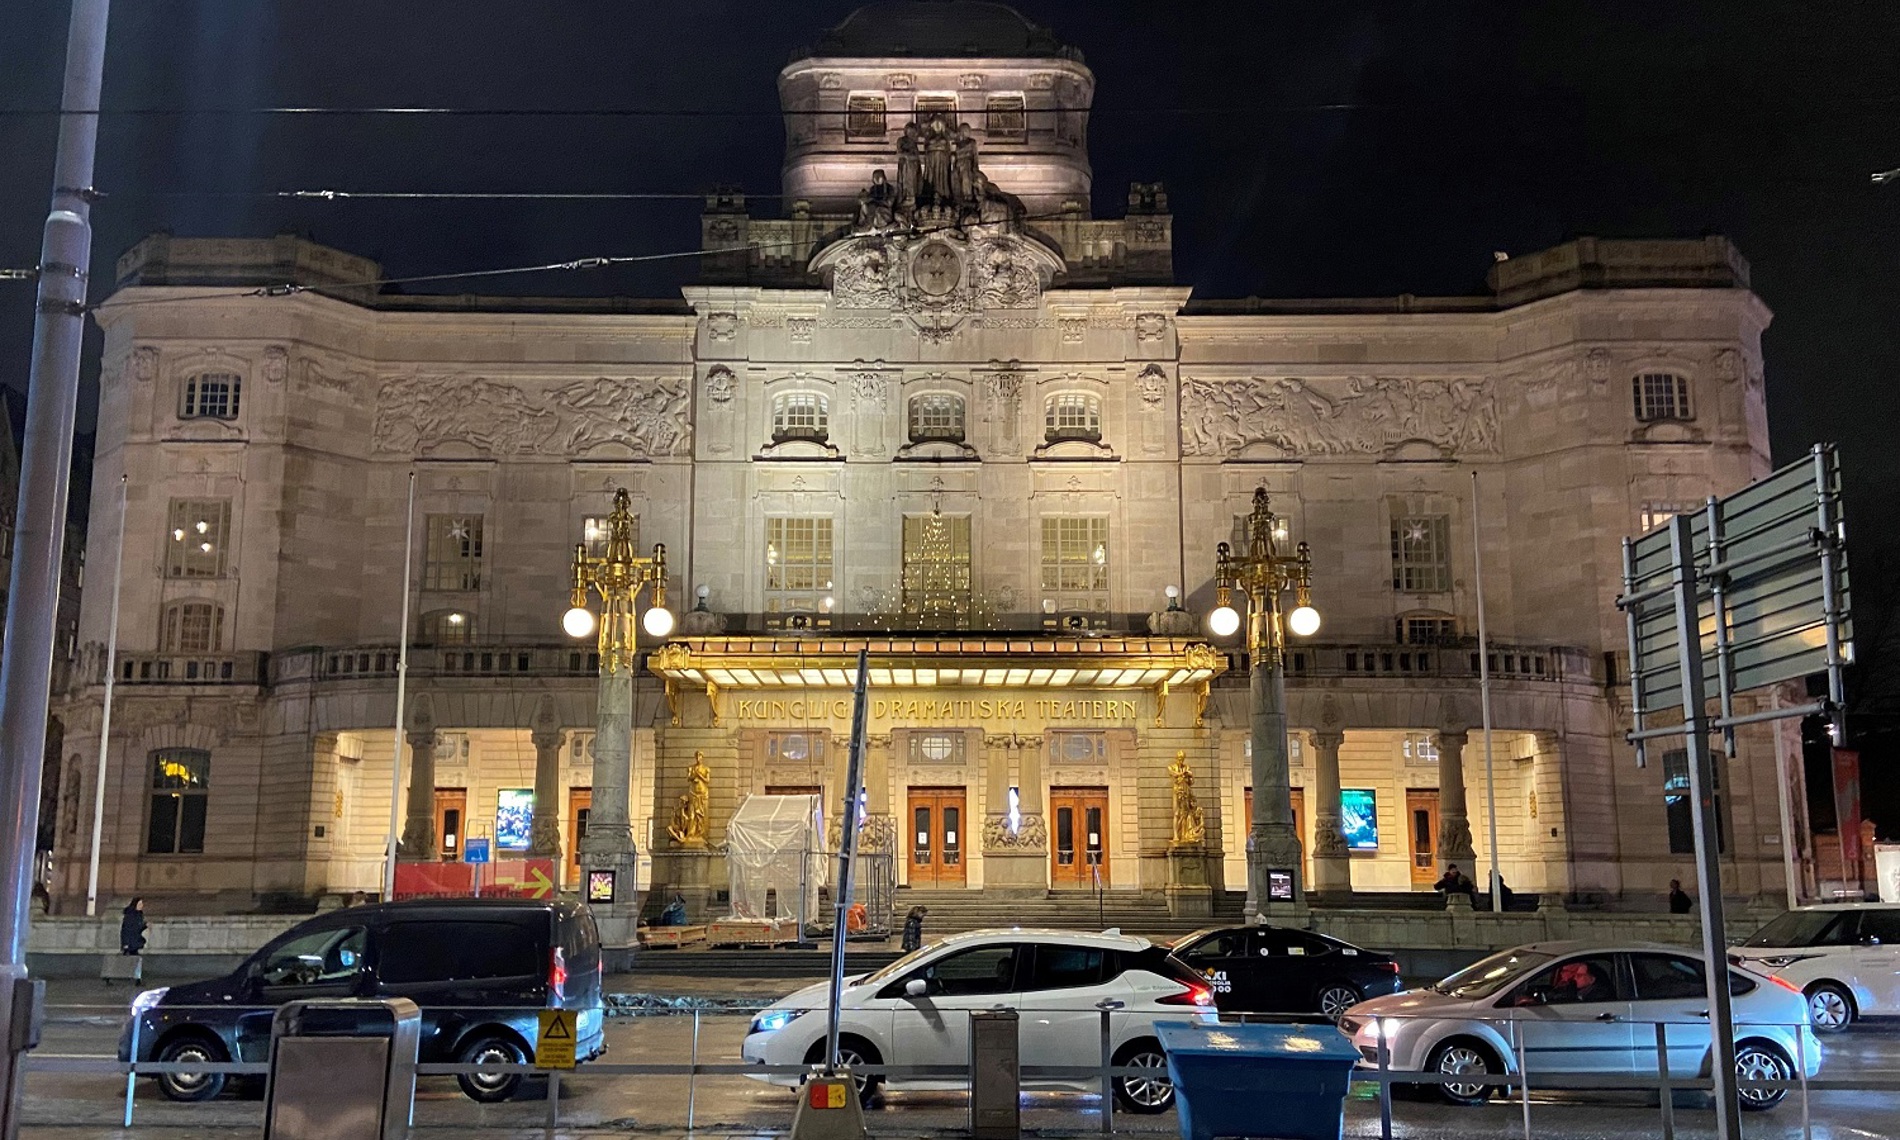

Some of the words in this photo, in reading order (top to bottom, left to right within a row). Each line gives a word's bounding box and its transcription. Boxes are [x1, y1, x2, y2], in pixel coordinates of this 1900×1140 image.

[738, 700, 853, 720] KUNGLIG
[874, 700, 1025, 720] DRAMATISKA
[1036, 700, 1136, 720] TEATERN
[1203, 971, 1227, 981] XI
